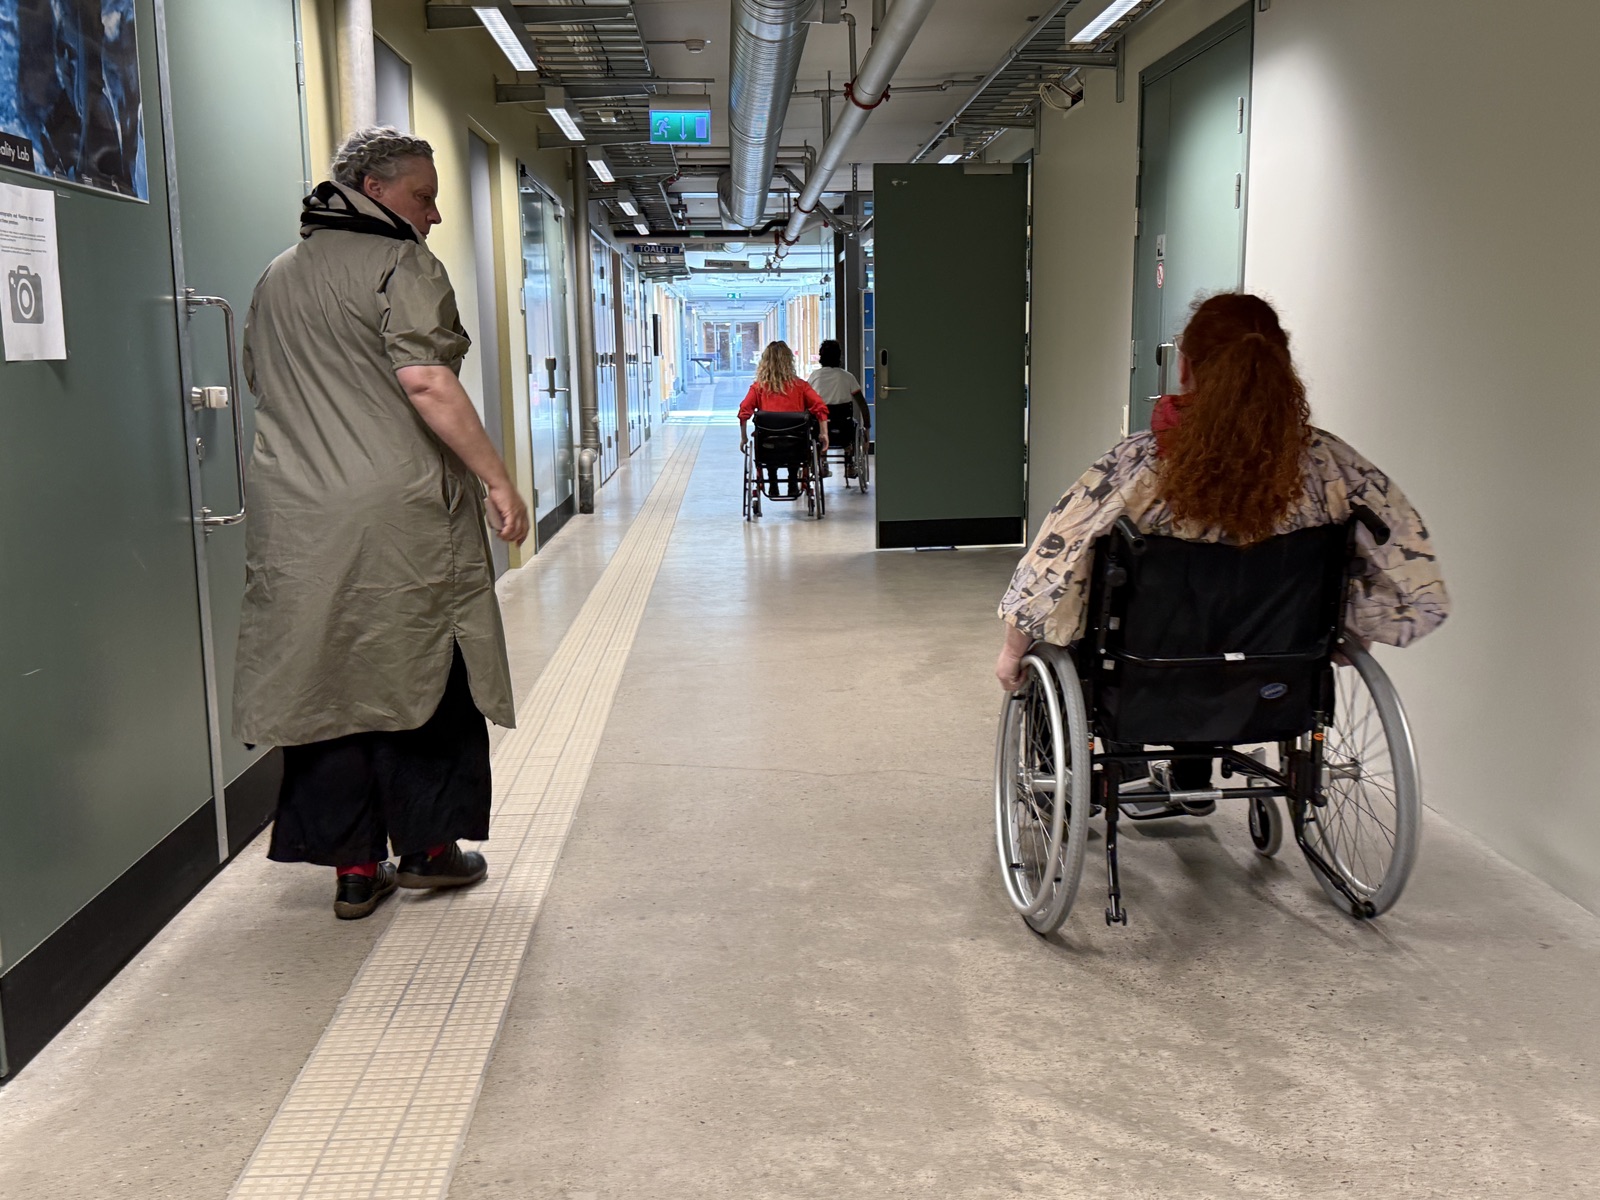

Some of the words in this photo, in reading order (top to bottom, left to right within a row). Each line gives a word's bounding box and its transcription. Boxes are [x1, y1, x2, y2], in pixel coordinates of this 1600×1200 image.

[0, 141, 15, 162] ality
[17, 145, 30, 162] Lab
[639, 245, 674, 253] TOALETT
